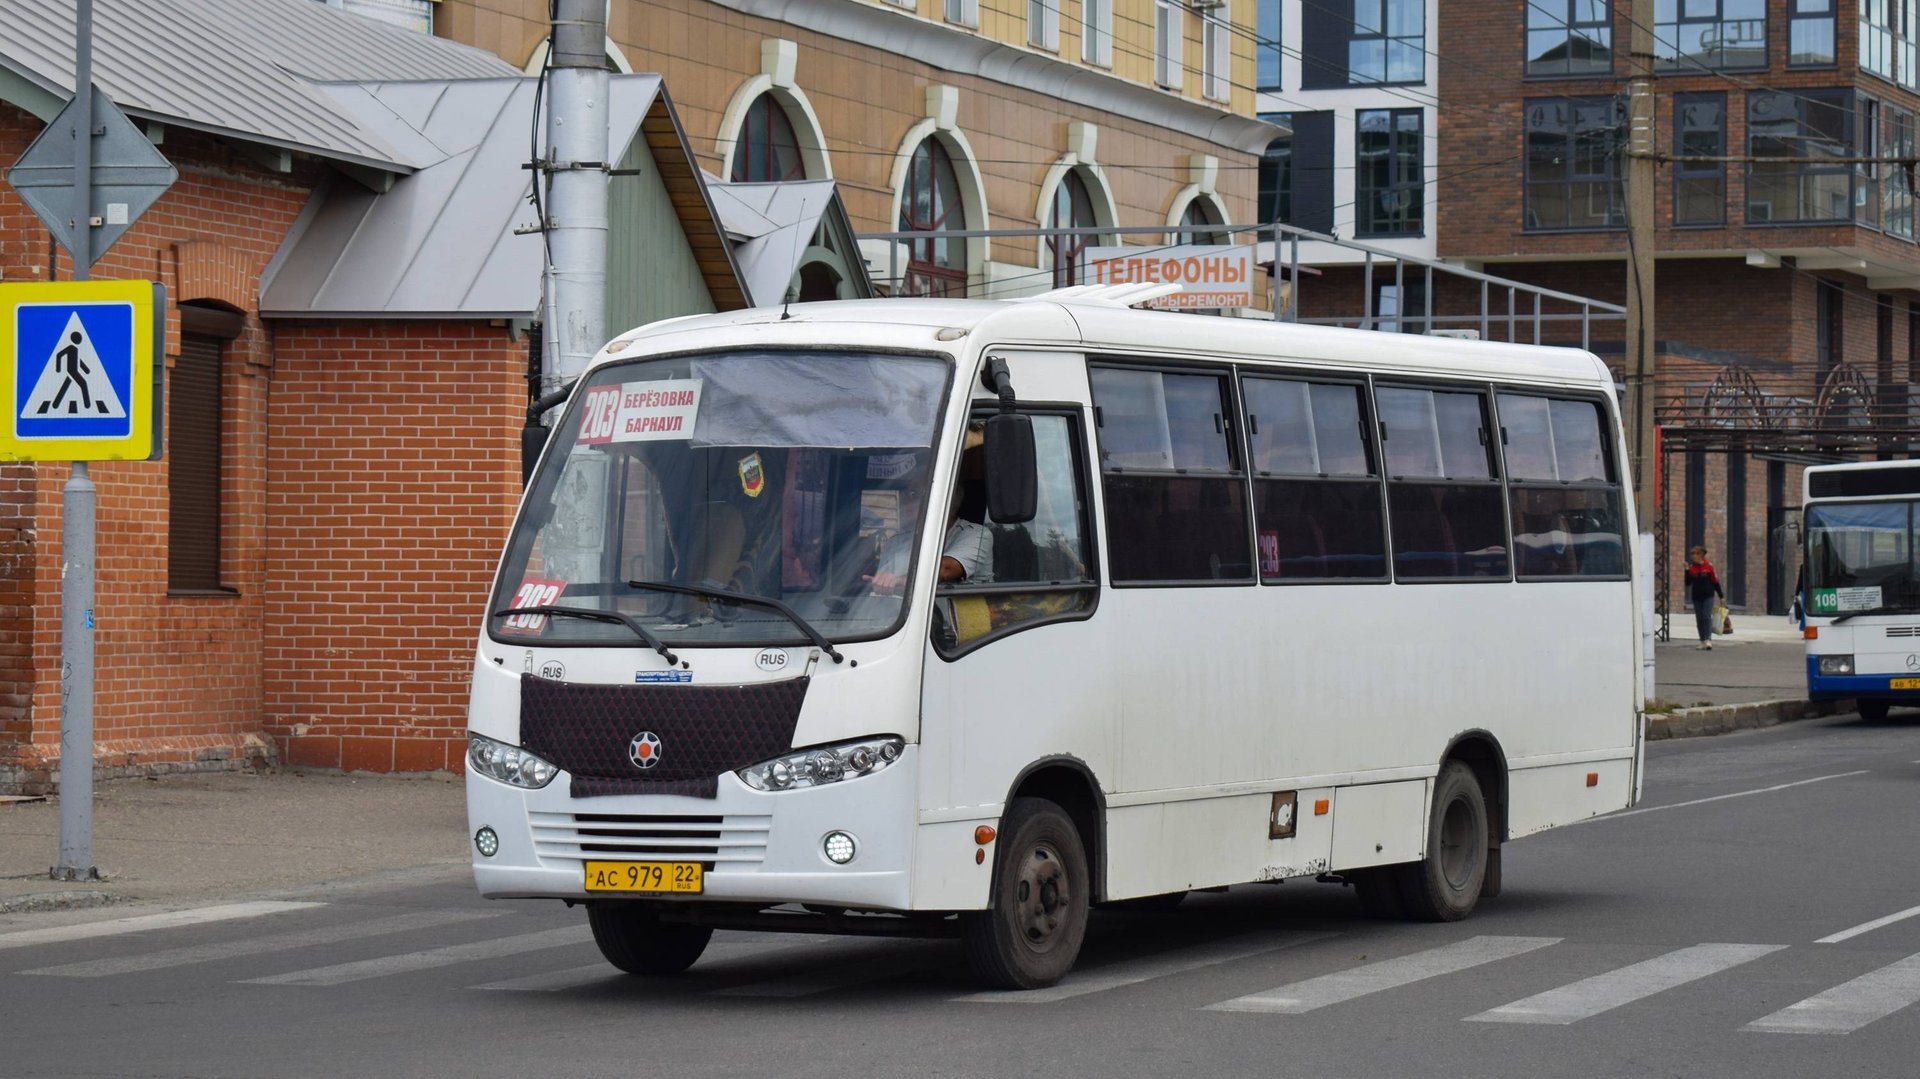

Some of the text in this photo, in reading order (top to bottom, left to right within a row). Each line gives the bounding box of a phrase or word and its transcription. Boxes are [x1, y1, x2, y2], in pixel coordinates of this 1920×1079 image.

[1091, 257, 1246, 284] ТЕЛЕФОНЫ
[1187, 294, 1245, 307] РЕМОНТ
[623, 389, 695, 409] БЕРЁЗОВКА
[578, 390, 620, 439] 203
[625, 416, 684, 433] БАРНАУЛ
[506, 583, 559, 629] 203
[1814, 593, 1837, 607] 108
[760, 653, 785, 665] RUS
[542, 666, 563, 679] RUS
[627, 866, 663, 887] 979
[675, 865, 694, 882] 22
